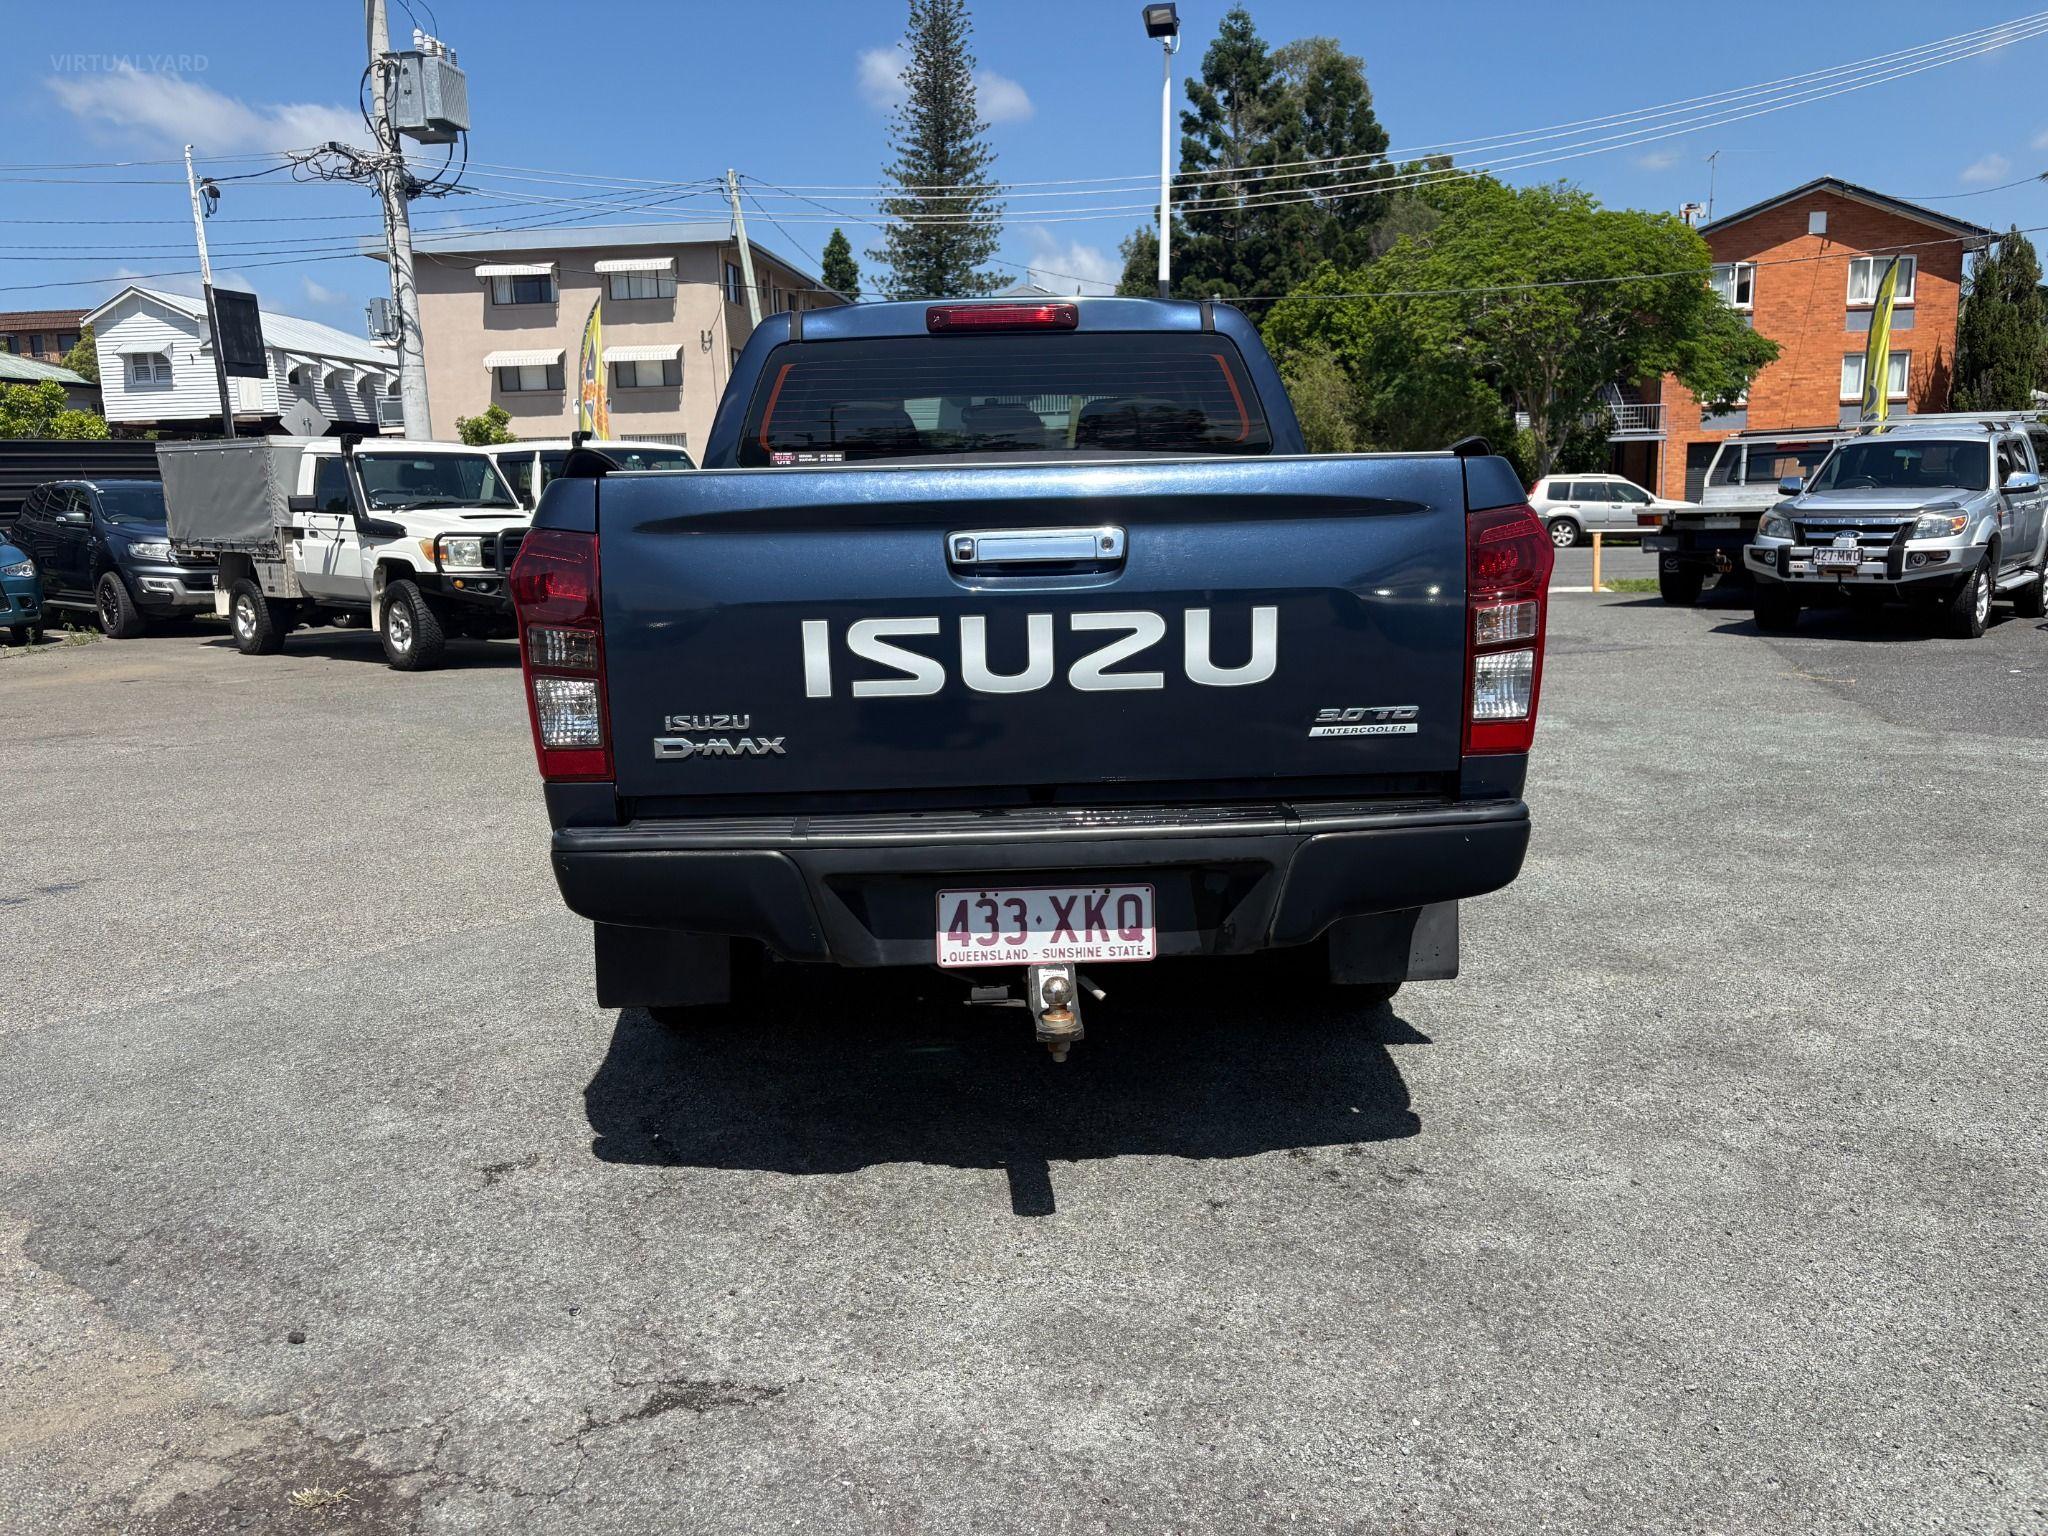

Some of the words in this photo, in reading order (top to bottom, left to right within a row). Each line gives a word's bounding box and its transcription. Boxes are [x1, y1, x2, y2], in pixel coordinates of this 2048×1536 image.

[802, 606, 1278, 698] ISUZU
[664, 715, 750, 731] ISUZU
[1321, 725, 1407, 735] INTERCOOLER
[653, 737, 787, 759] D-MAX
[949, 949, 1029, 962] QUEENSLAND
[1042, 946, 1102, 959] SUNSHINE
[1108, 945, 1144, 957] STATE
